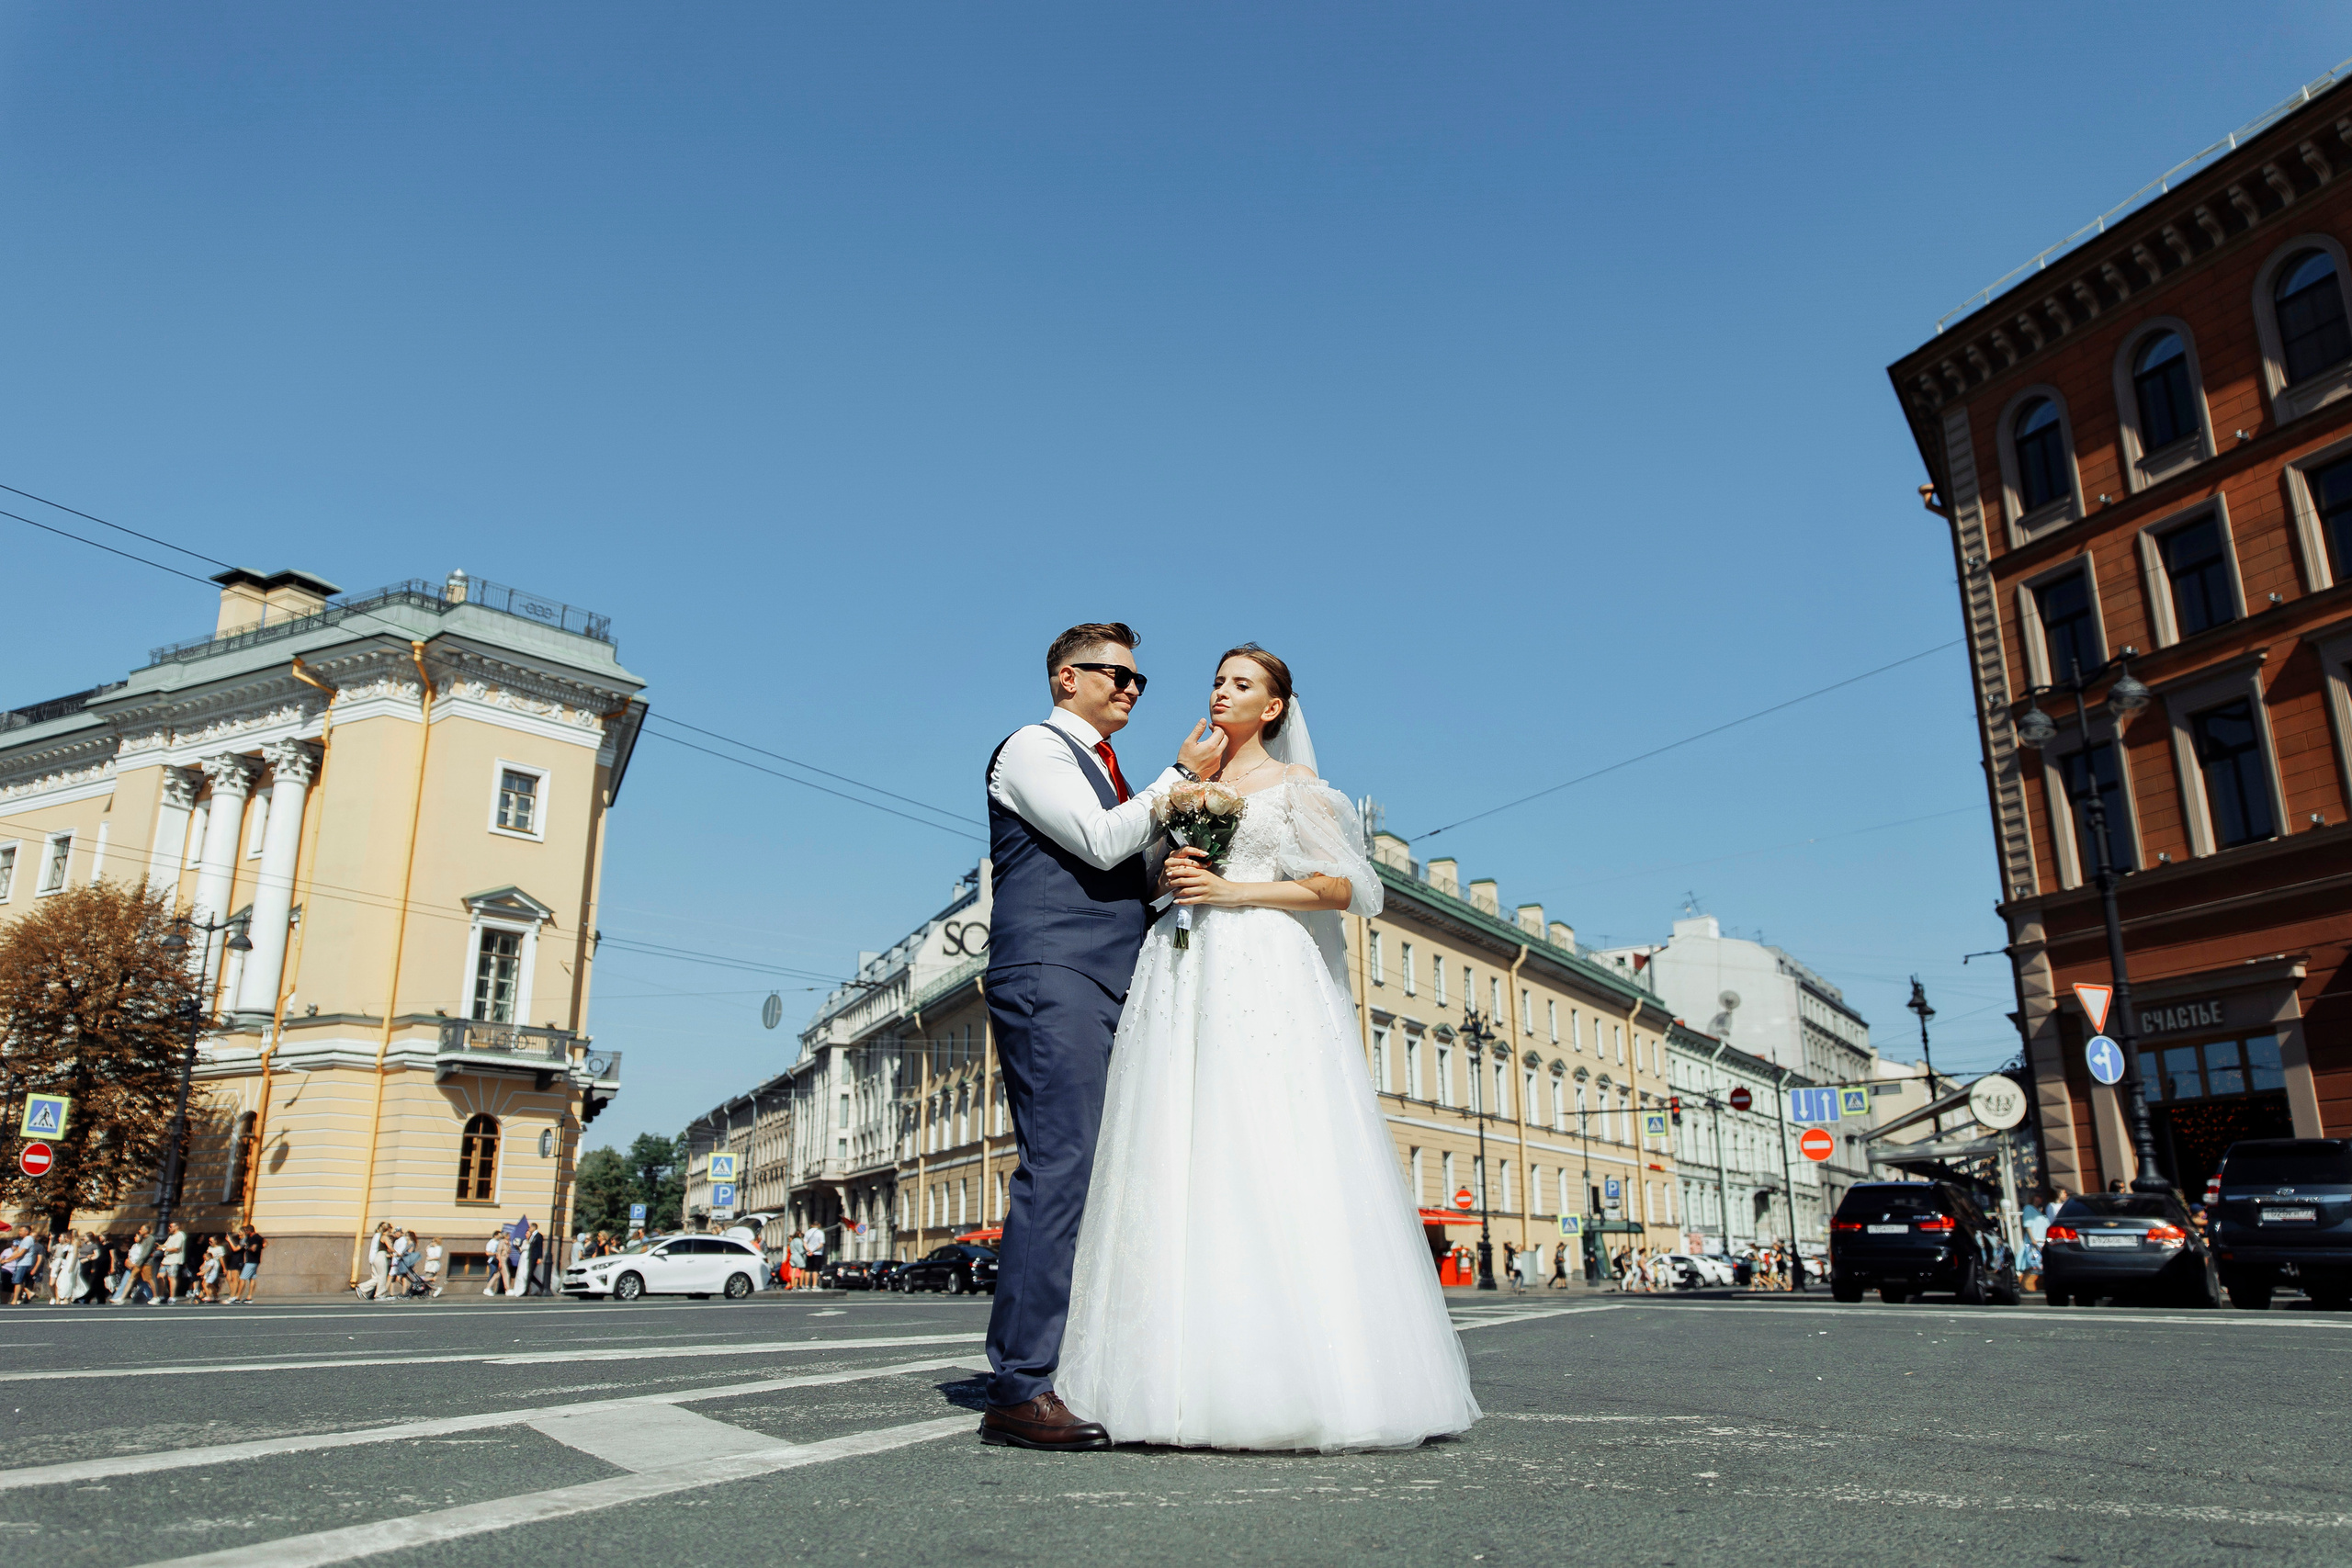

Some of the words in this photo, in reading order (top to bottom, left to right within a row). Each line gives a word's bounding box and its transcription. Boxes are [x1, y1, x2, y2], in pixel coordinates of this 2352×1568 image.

[2142, 1001, 2223, 1033] СЧАСТЬЕ
[718, 1187, 730, 1203] P
[1608, 1182, 1617, 1195] P
[634, 1206, 642, 1217] P
